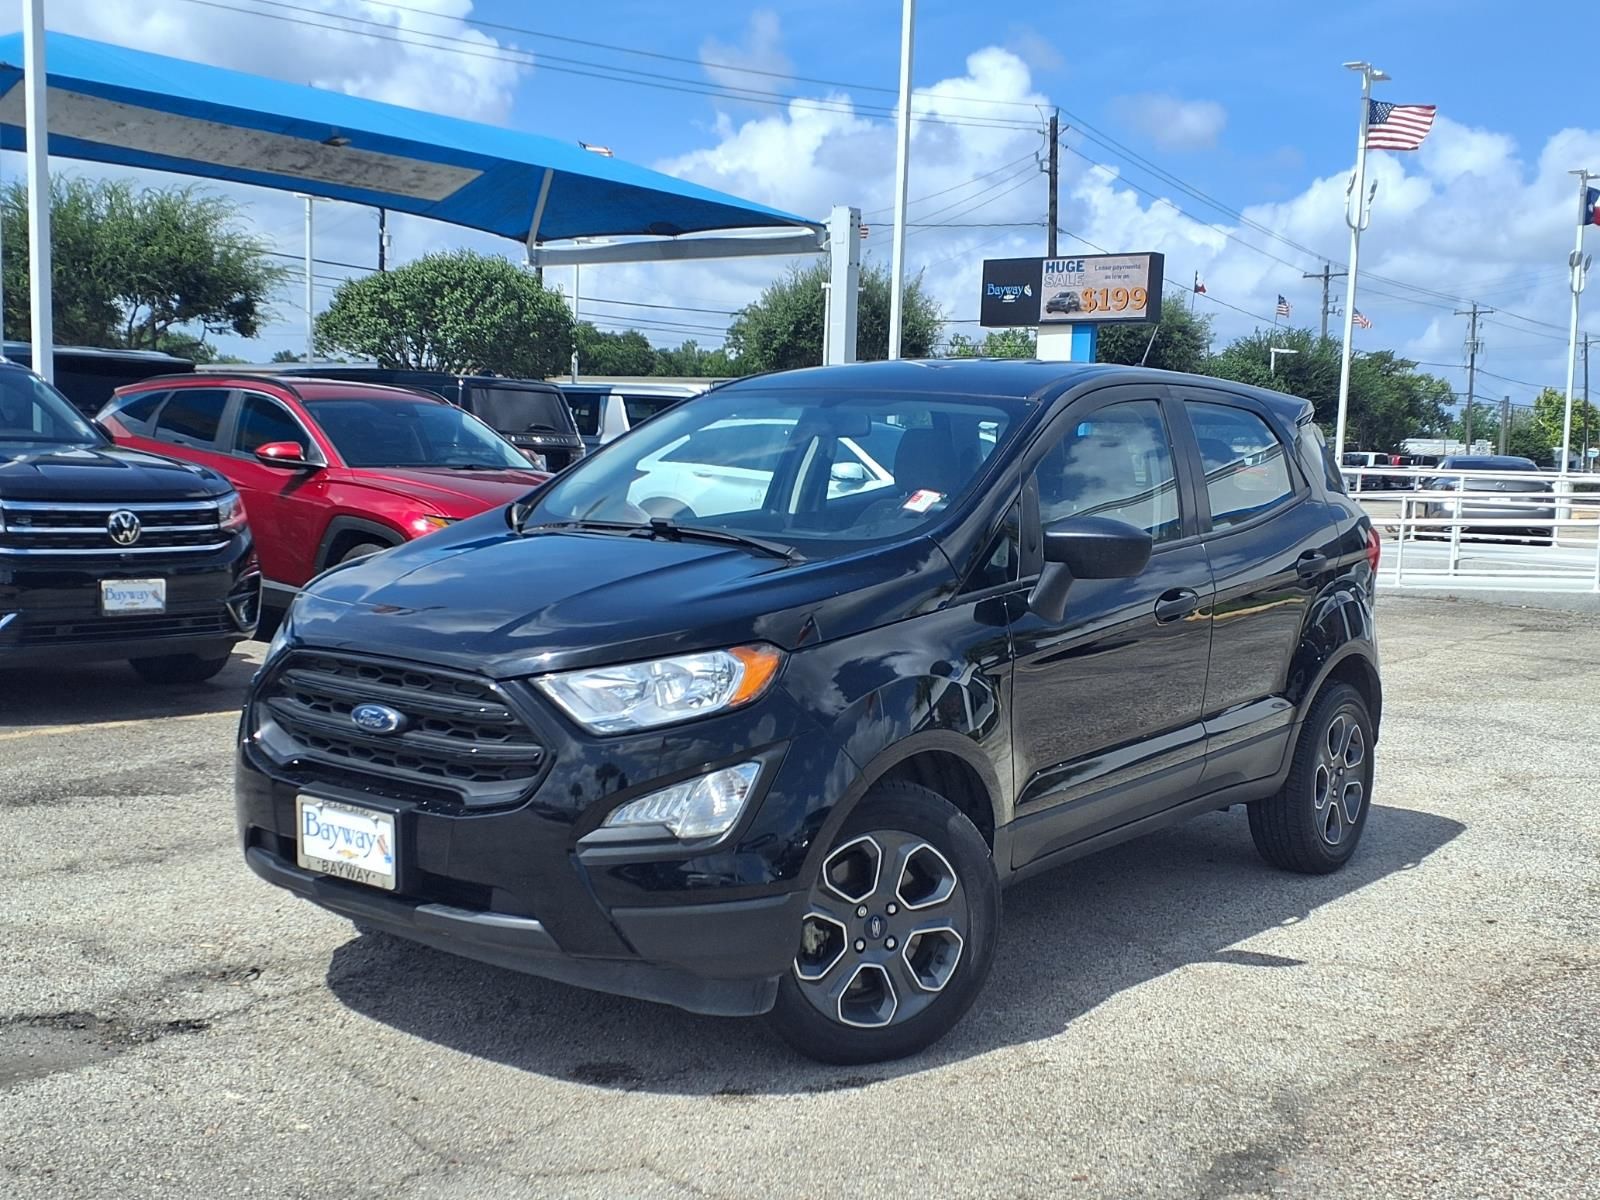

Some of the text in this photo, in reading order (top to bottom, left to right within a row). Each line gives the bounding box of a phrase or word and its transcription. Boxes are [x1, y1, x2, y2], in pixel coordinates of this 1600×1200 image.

[1045, 260, 1085, 273] HUGE
[1044, 273, 1084, 288] SALE
[987, 283, 1024, 299] Bayway
[1080, 287, 1148, 313] $199
[105, 587, 150, 604] Bayway
[303, 811, 376, 858] Bayway
[321, 860, 371, 883] BAYWAY
